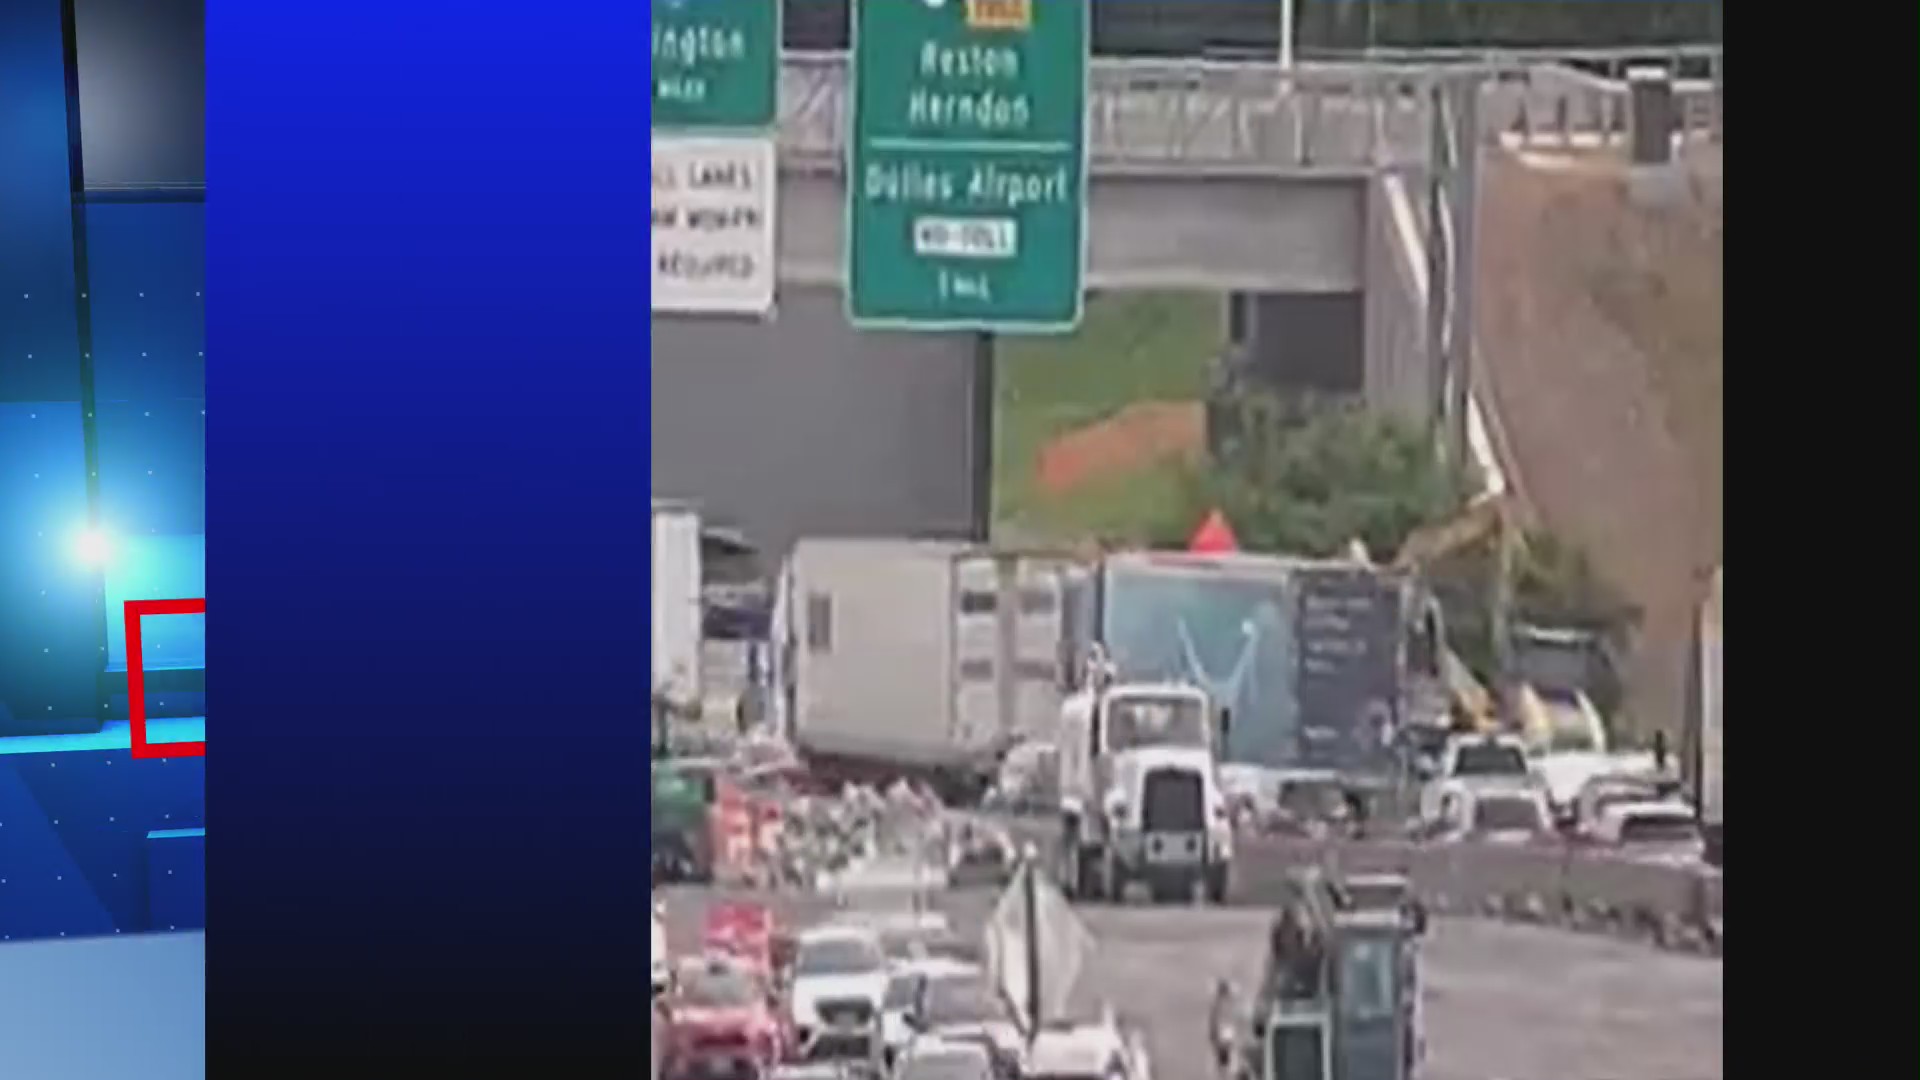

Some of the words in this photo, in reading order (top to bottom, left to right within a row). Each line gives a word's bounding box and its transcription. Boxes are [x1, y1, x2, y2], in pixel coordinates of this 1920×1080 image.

[921, 42, 1018, 77] Reston
[909, 88, 1029, 127] Herndon
[866, 163, 952, 199] Dulles
[967, 161, 1067, 207] Airport
